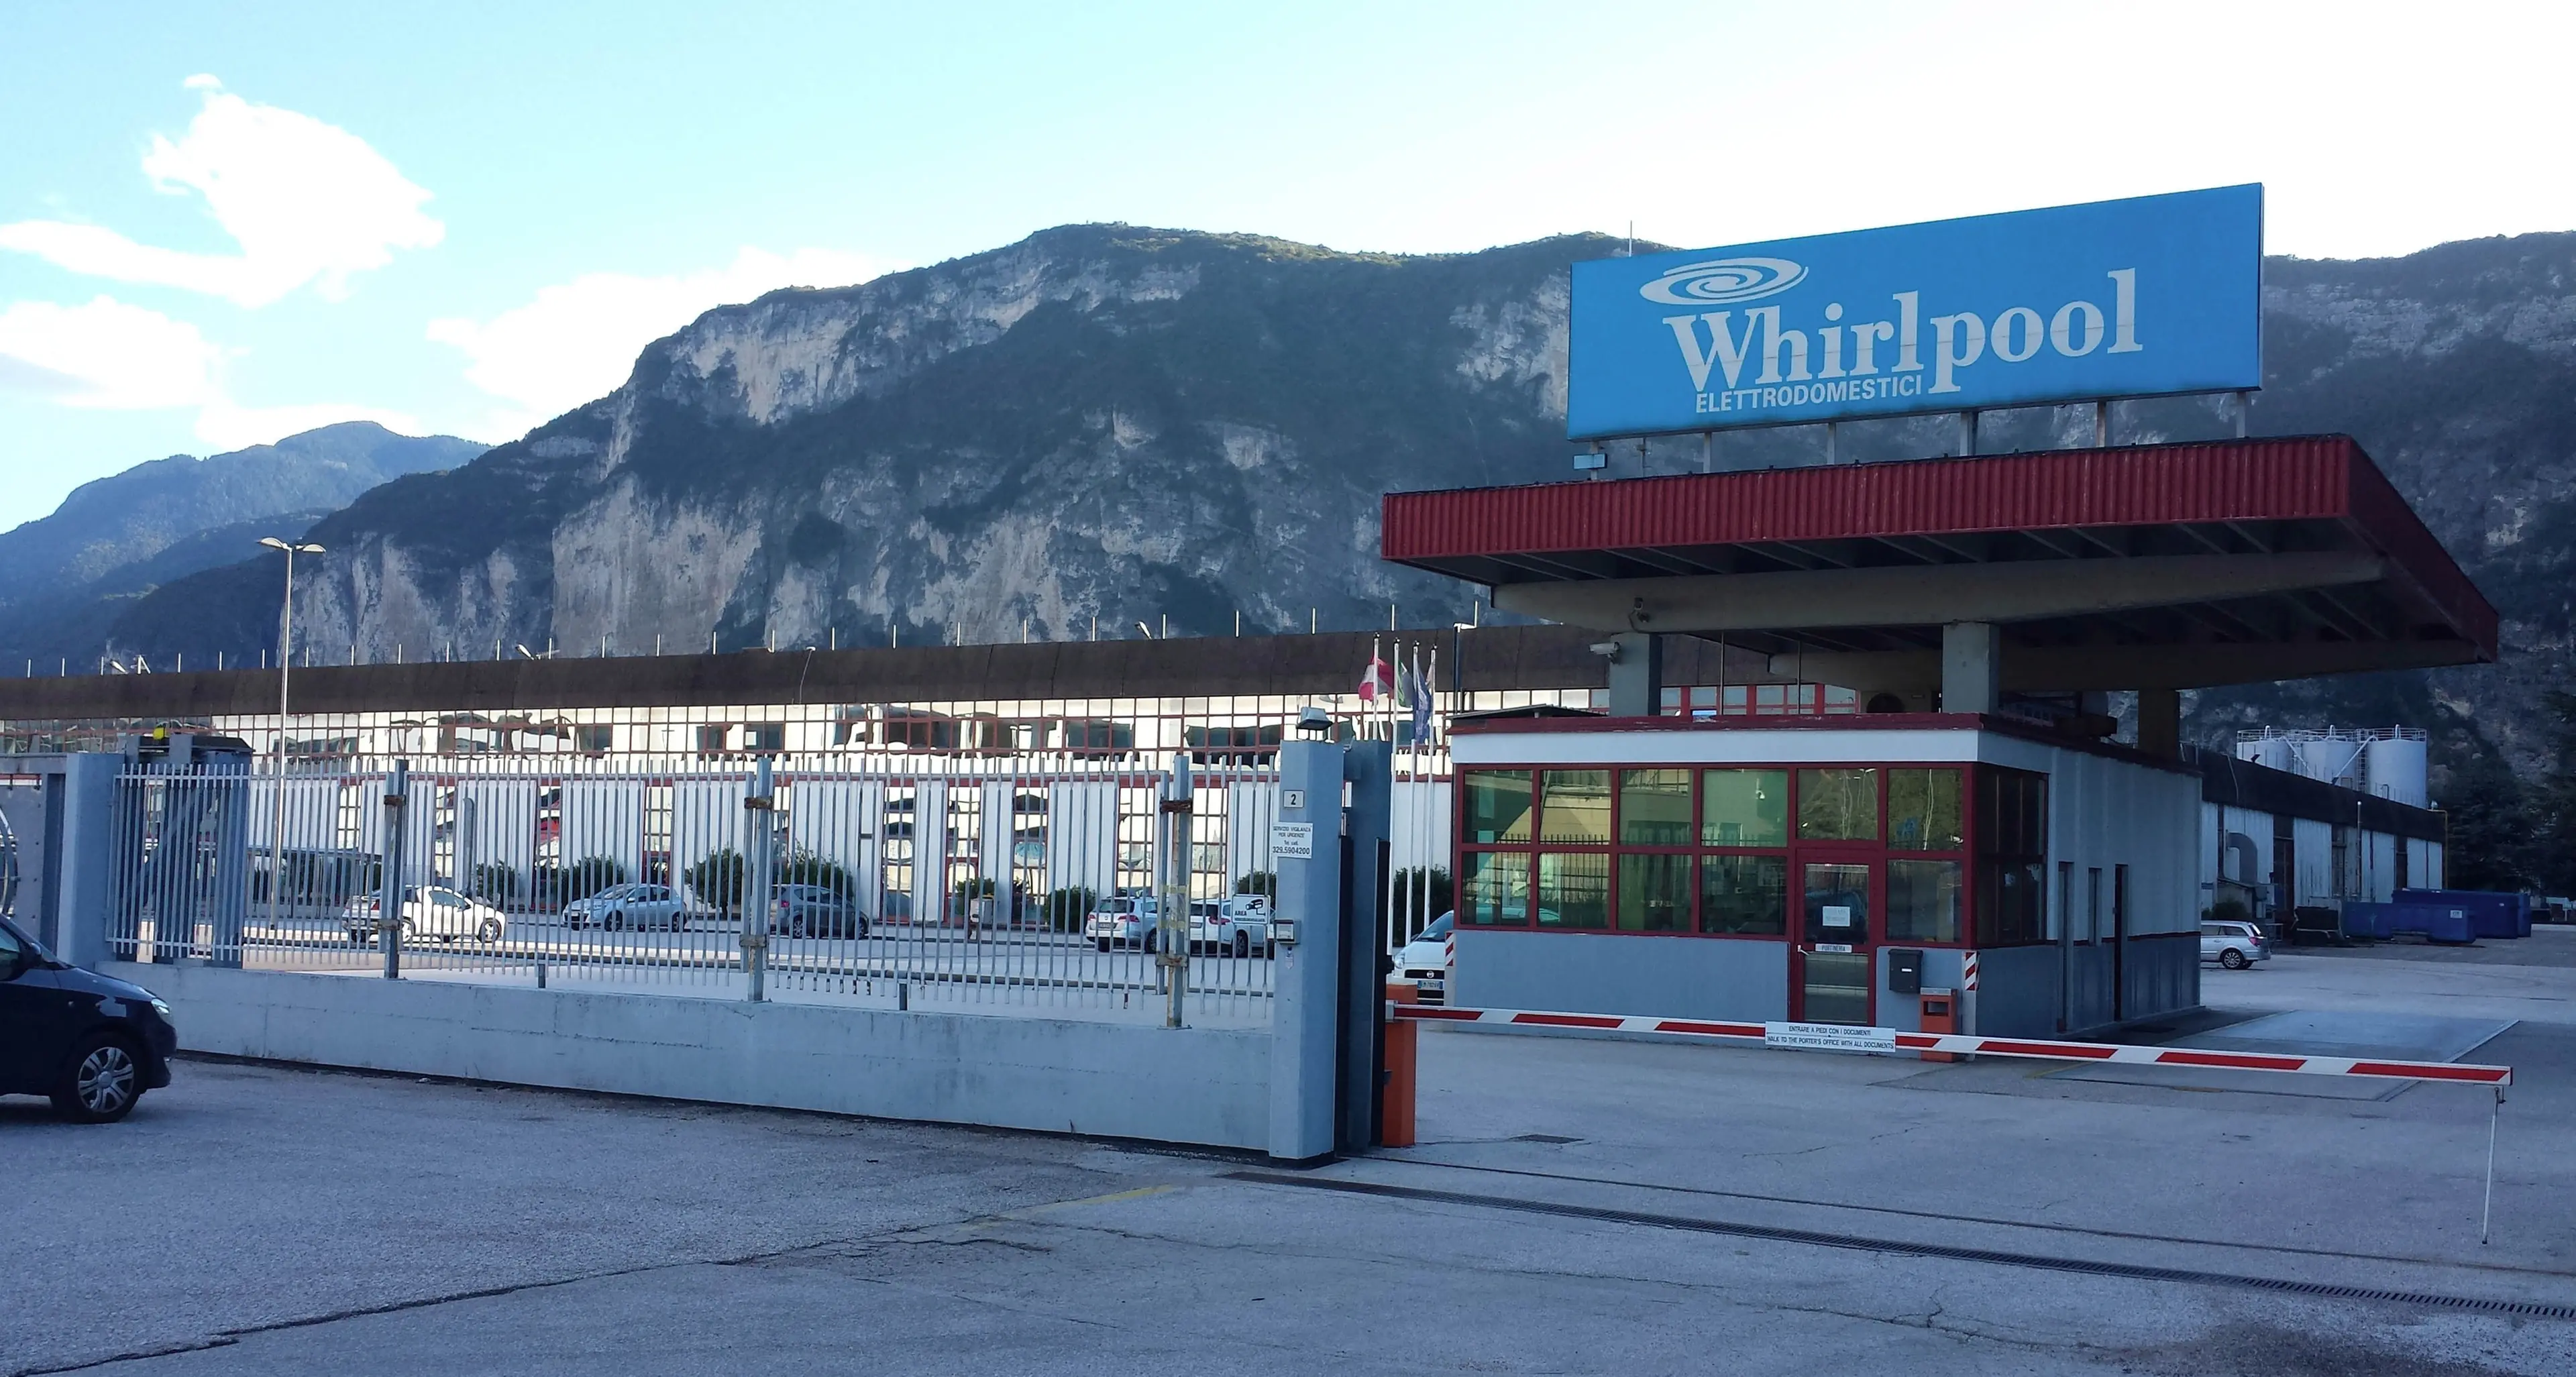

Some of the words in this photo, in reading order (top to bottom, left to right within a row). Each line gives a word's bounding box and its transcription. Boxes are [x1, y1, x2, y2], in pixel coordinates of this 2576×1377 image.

[1662, 268, 2143, 394] Whirlpool
[1696, 375, 1921, 413] ELETTRODOMESTICI
[1291, 793, 1296, 805] 2
[1843, 1028, 1871, 1036] DOCUMENTI
[1864, 1041, 1894, 1050] DOCUMENTS
